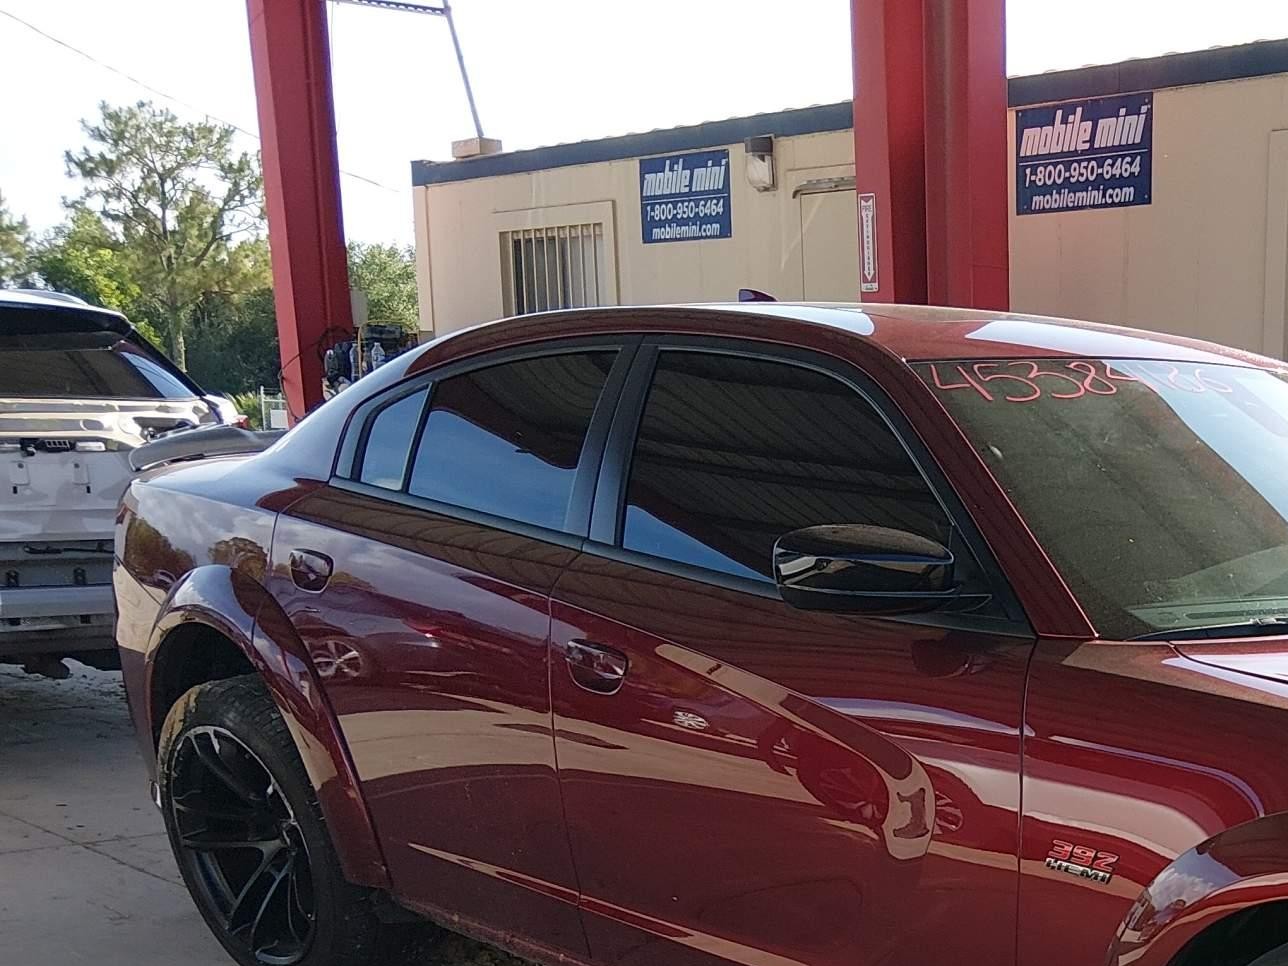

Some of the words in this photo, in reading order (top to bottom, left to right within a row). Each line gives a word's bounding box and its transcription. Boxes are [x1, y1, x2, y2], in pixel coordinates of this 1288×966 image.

[1020, 107, 1092, 157] mobile
[1094, 105, 1148, 148] mini
[642, 158, 691, 196] mobile
[691, 159, 727, 192] mini
[1025, 155, 1141, 188] 1-800-950-6464
[646, 198, 724, 221] 1-800-950-6464
[1031, 185, 1135, 210] mobilemini.com
[651, 221, 720, 240] mobilemini.com
[1044, 857, 1113, 885] HEMI
[1048, 839, 1119, 873] 392
